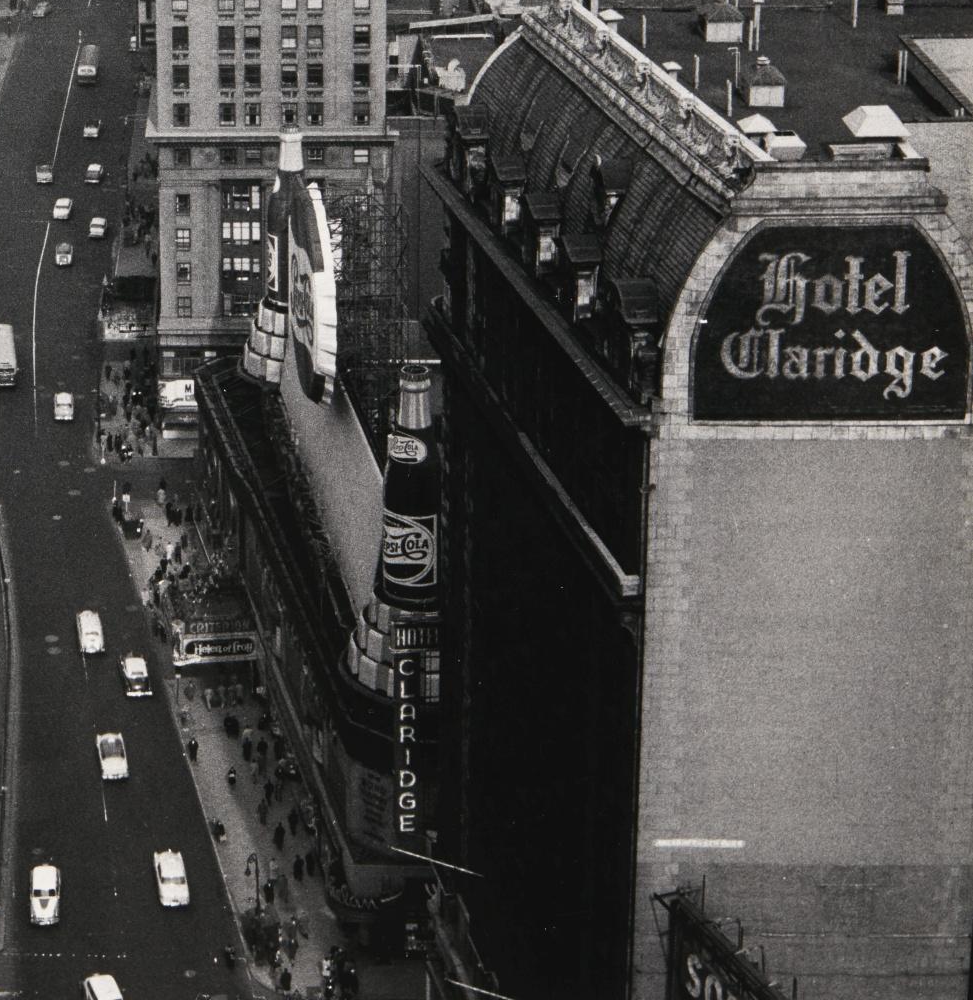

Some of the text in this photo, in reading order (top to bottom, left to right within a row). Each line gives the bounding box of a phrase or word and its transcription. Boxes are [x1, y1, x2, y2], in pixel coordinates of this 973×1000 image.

[755, 250, 913, 326] Hotel
[719, 325, 949, 401] Claridge
[398, 659, 417, 832] CLARIDGE
